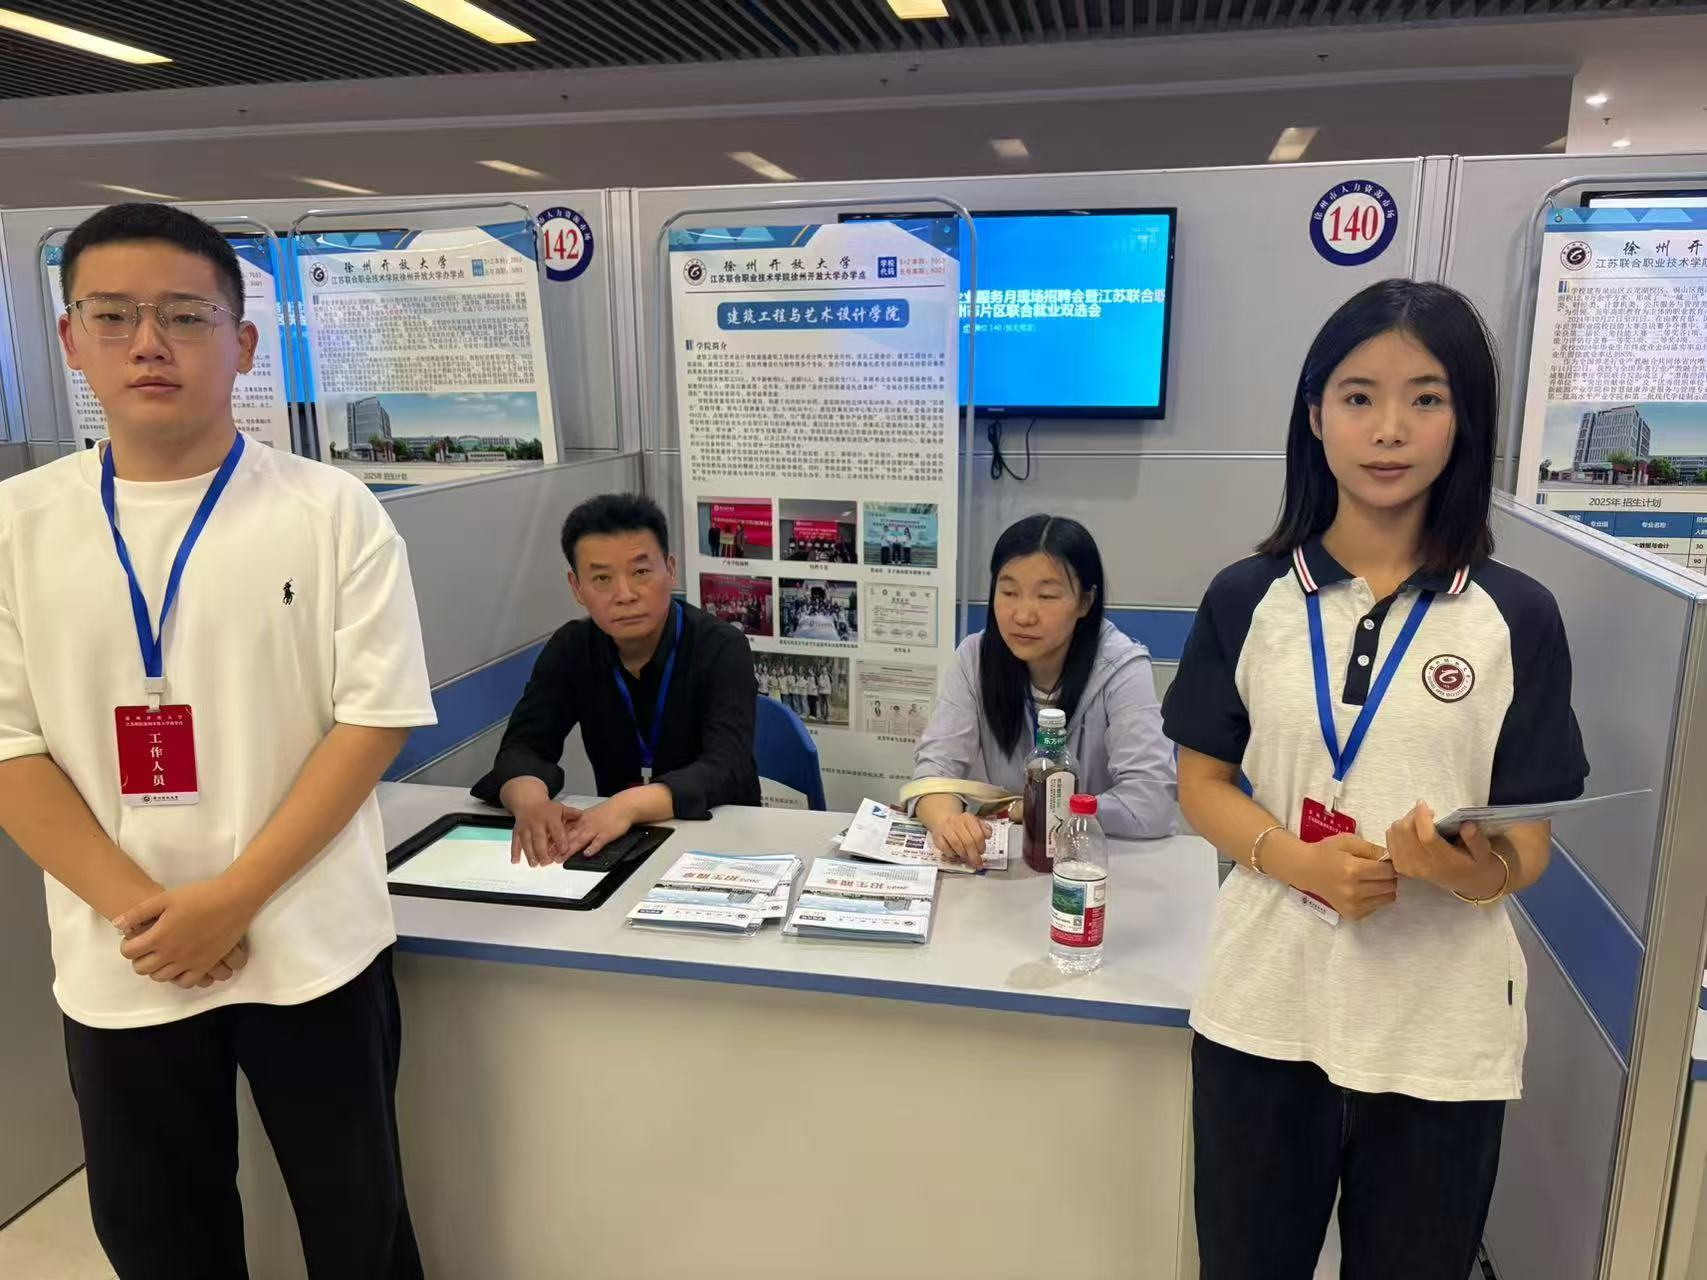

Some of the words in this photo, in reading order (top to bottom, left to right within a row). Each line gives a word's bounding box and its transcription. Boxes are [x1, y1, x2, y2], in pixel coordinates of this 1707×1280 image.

[1329, 205, 1379, 241] 140
[543, 228, 579, 260] 142
[1622, 239, 1703, 257] 徐州开
[344, 254, 448, 274] 徐州开放大学
[723, 256, 852, 273] 徐州开放大学
[710, 270, 866, 284] 江苏联合职业技术学院徐州开放大学办学点
[727, 305, 901, 326] 建筑工程与艺术设计学院
[696, 342, 727, 351] 学院简介
[1588, 497, 1621, 507] 2025年
[1622, 497, 1662, 508] 招生计划
[148, 733, 166, 787] 工作人员
